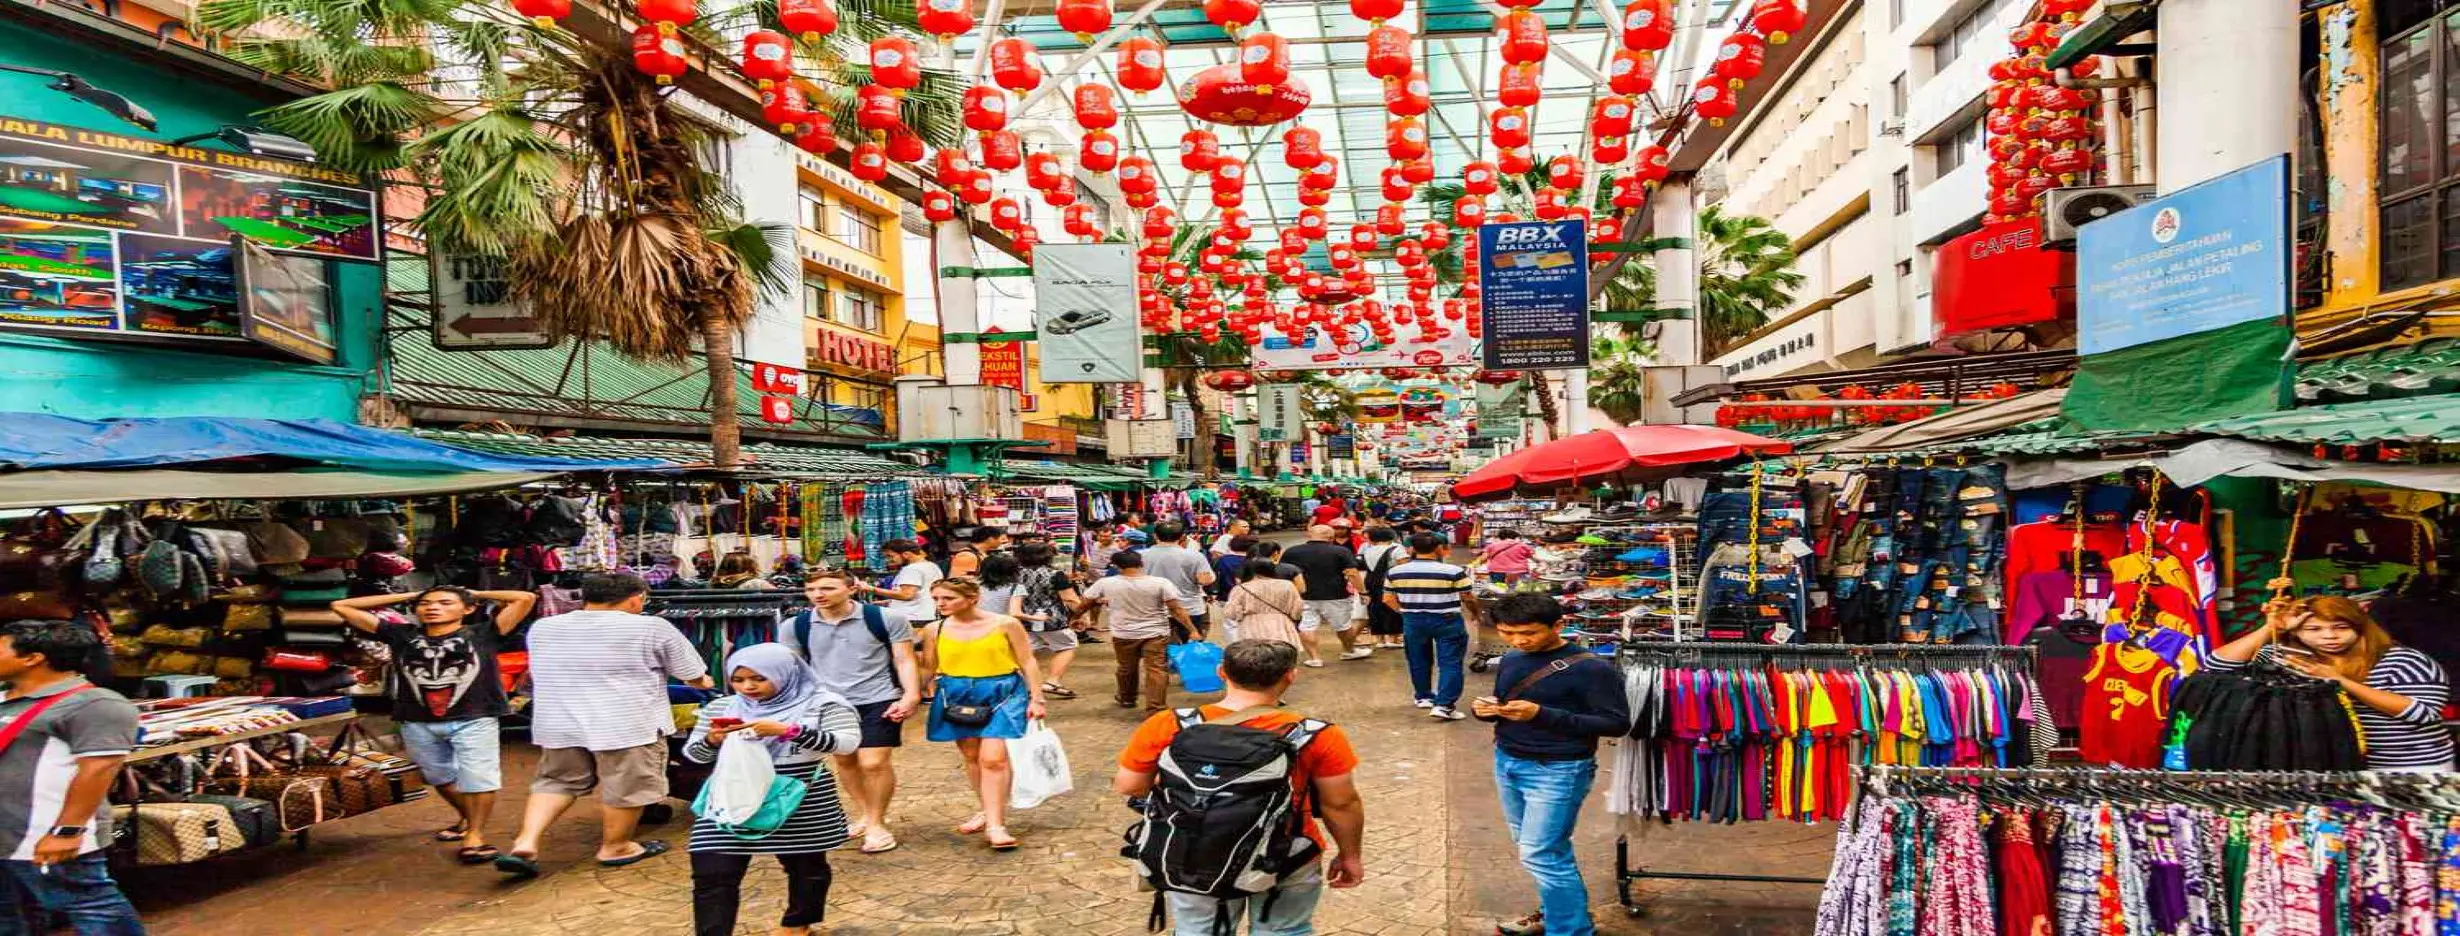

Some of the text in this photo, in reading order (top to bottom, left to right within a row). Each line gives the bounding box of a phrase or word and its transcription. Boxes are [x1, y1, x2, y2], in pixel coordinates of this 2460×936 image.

[0, 119, 360, 185] ALA LUMPUR BRANCHES
[1496, 242, 1567, 251] MALAYSIA
[1497, 225, 1566, 244] BBX
[1970, 228, 2034, 260] CAFE
[817, 328, 897, 375] HOTEL
